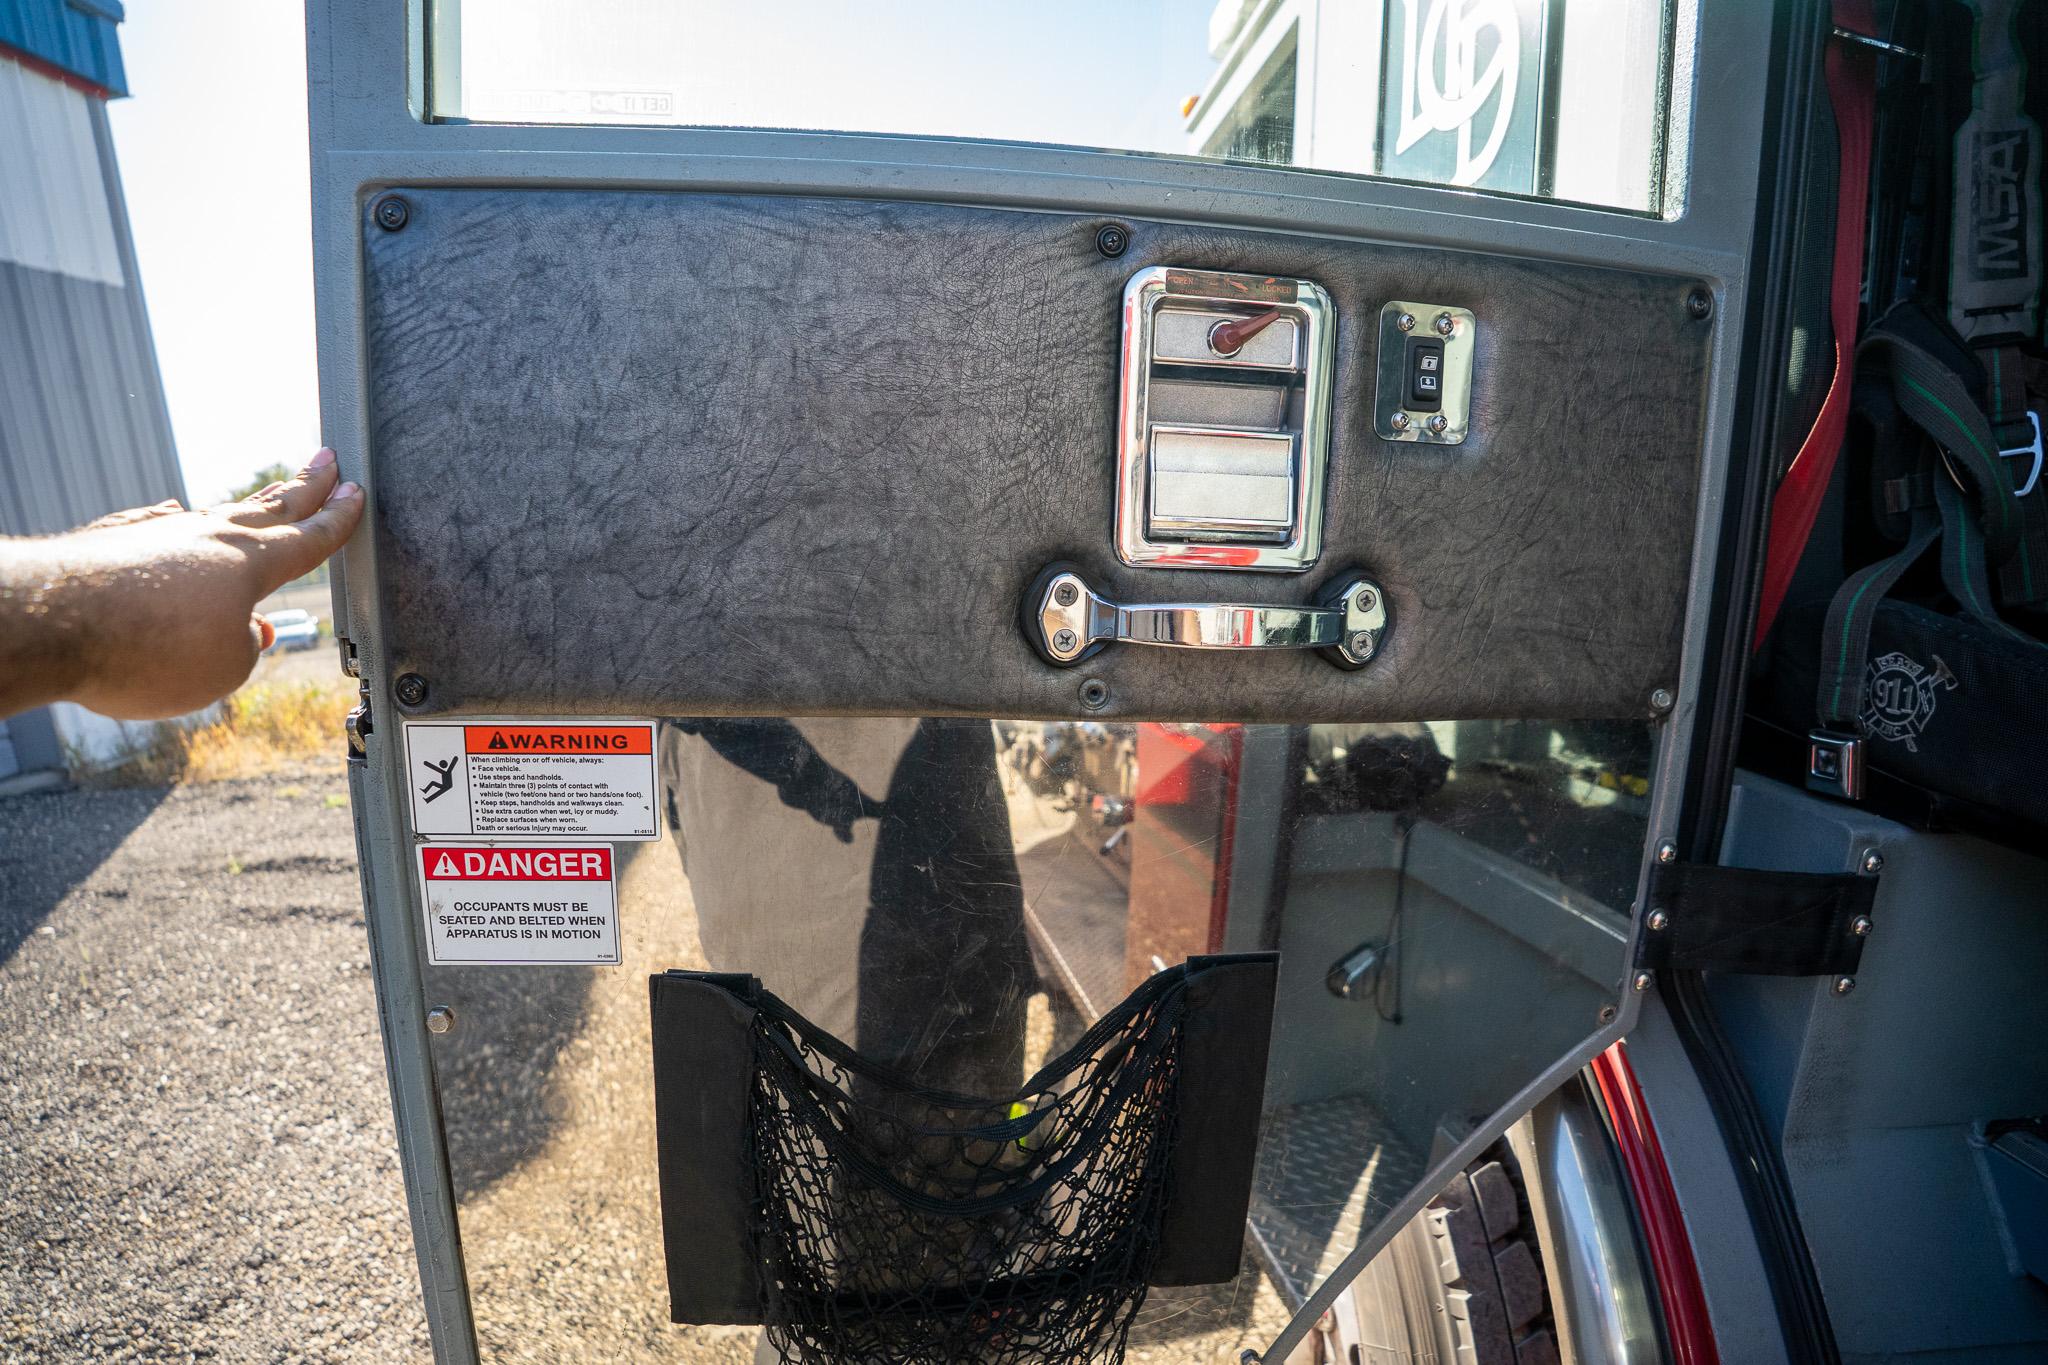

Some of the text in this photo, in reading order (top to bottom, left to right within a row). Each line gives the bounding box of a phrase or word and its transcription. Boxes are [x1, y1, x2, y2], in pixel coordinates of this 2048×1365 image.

[1977, 134, 2023, 270] MSA
[1262, 284, 1292, 294] LOCKED
[1874, 678, 1914, 715] 911
[510, 734, 628, 749] WARNING
[579, 757, 604, 765] always:
[464, 852, 603, 877] DANGER
[453, 902, 588, 912] OCCUPANTS MUST BE
[439, 915, 606, 926] SEATED AND BELTED WHEN
[446, 929, 601, 939] APPARATUS IS IN MOTION
